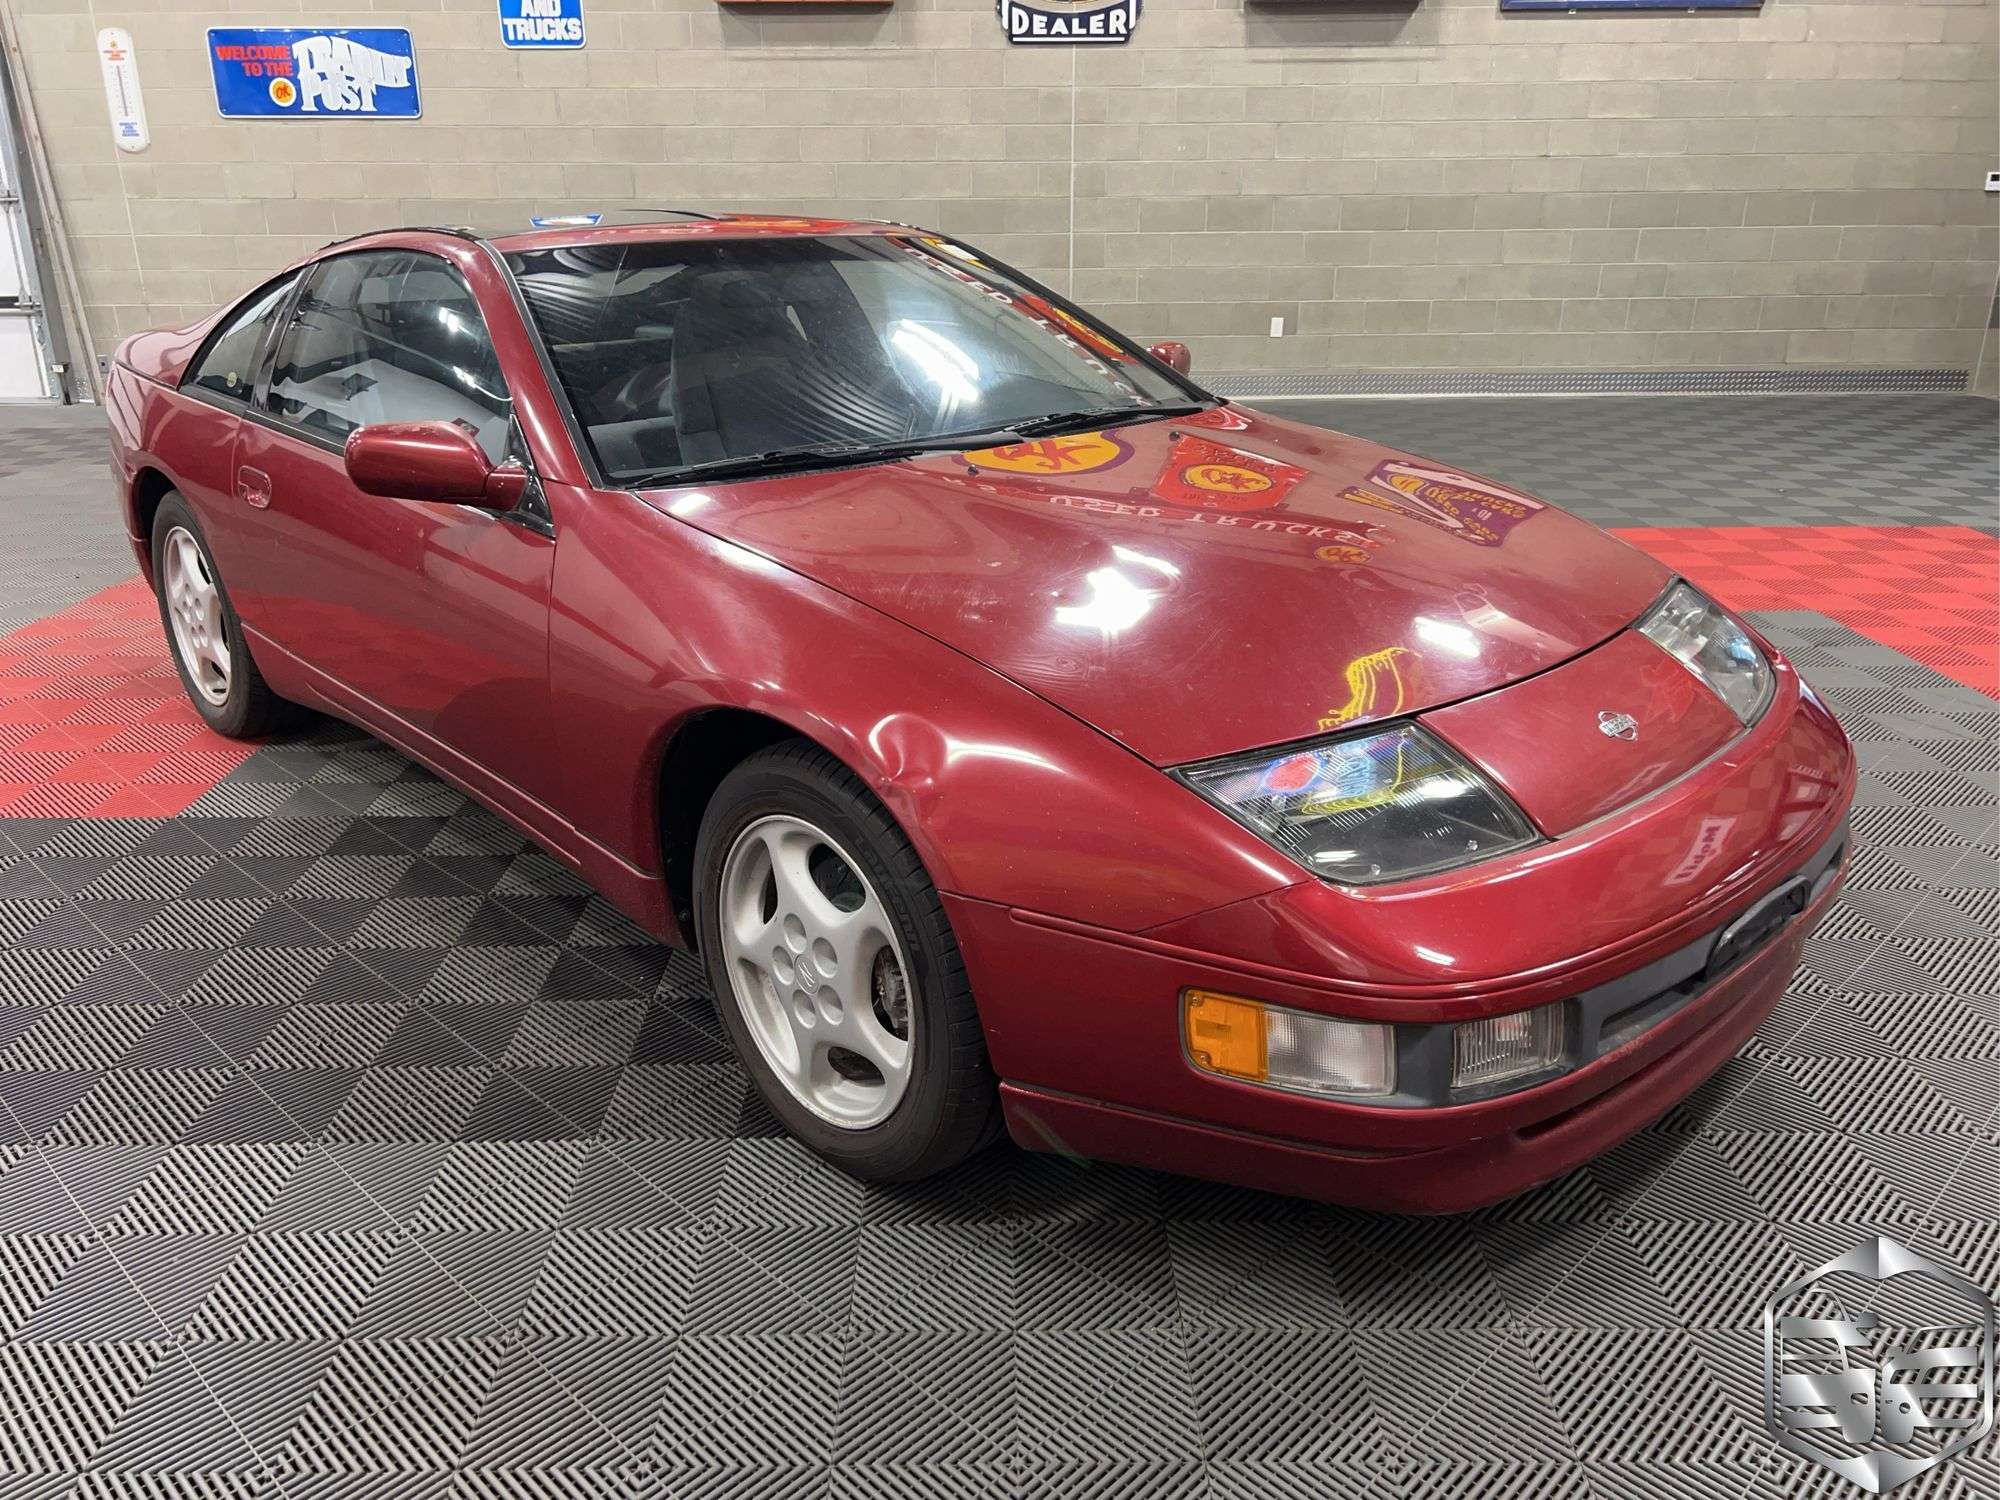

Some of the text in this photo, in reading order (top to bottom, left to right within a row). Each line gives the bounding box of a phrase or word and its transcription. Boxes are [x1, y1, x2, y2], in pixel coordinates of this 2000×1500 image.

[521, 0, 562, 17] AND
[1011, 6, 1128, 35] DEALER
[503, 18, 582, 41] TRUCKS
[215, 45, 290, 60] WELCOME
[241, 61, 294, 77] TO THE
